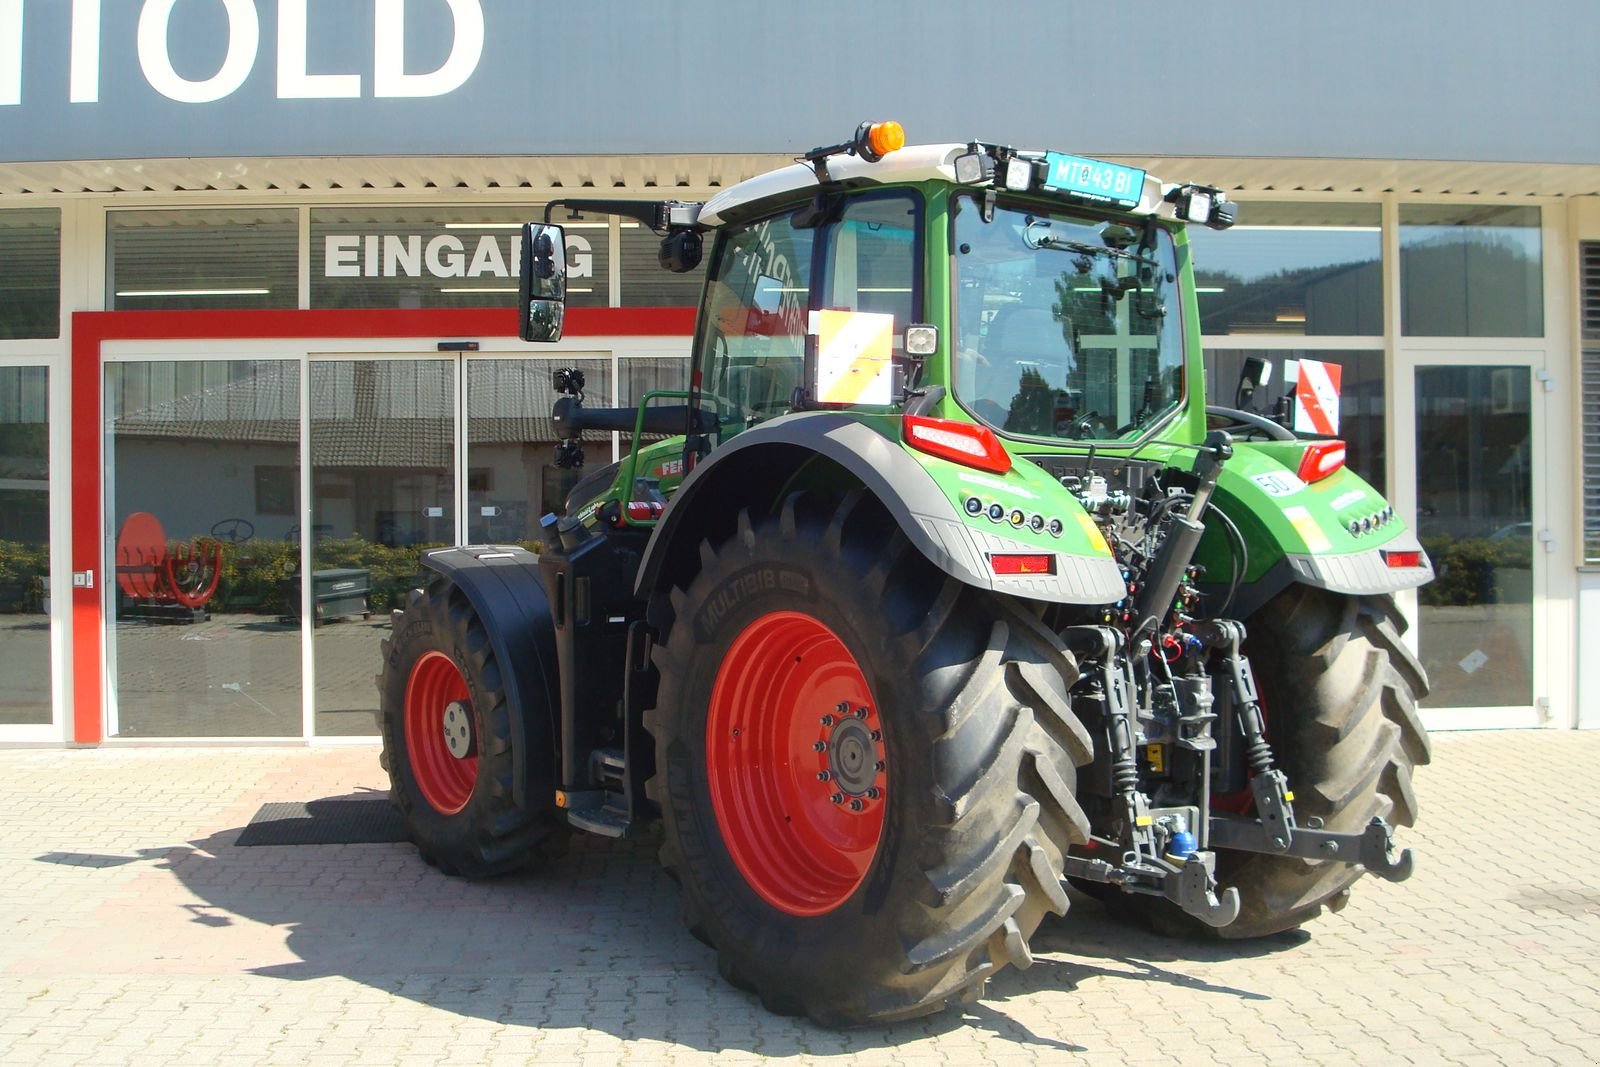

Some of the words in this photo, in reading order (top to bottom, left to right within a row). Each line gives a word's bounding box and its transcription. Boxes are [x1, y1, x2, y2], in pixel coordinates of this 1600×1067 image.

[1056, 159, 1082, 185] MT
[324, 234, 592, 278] EINGAG
[1256, 475, 1290, 494] 50
[701, 569, 776, 636] MULTIBIB
